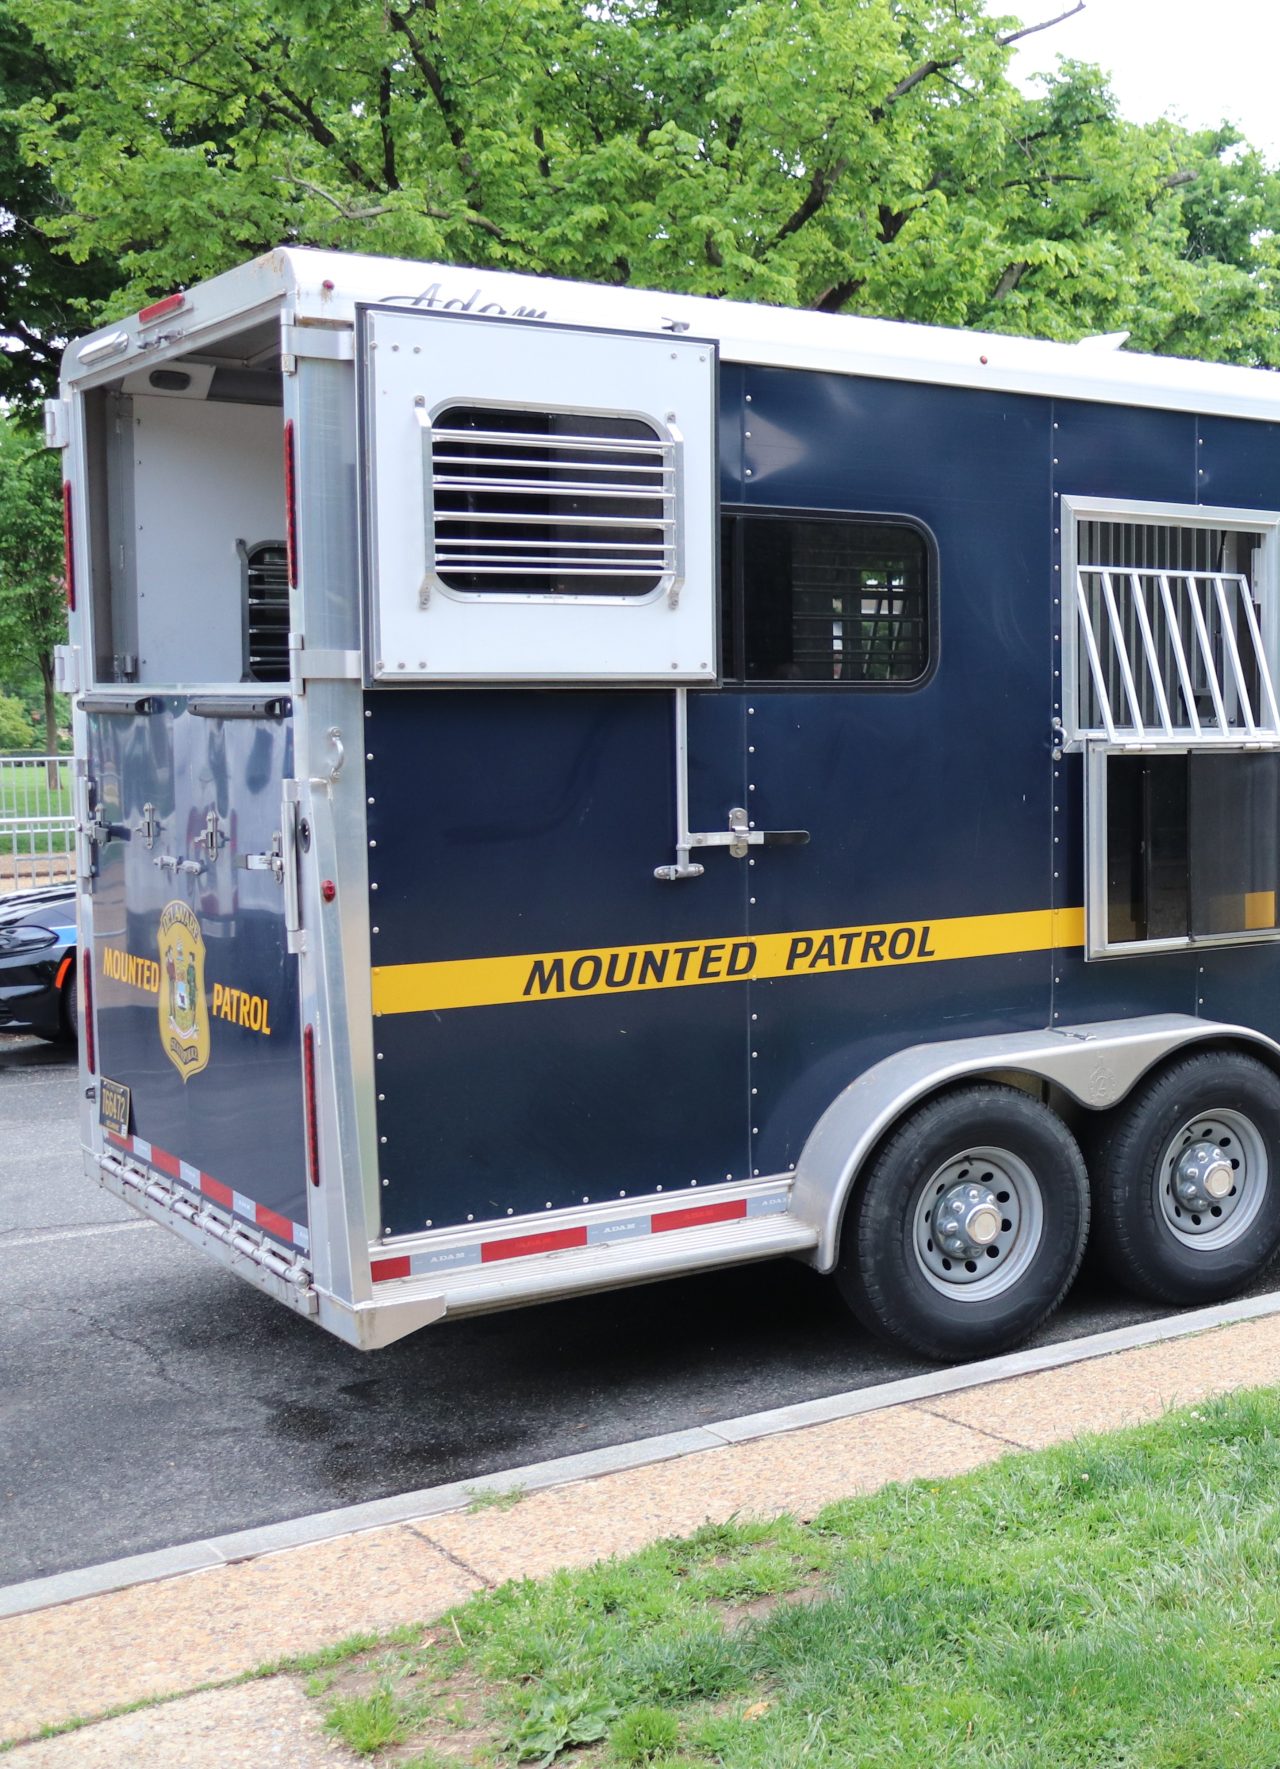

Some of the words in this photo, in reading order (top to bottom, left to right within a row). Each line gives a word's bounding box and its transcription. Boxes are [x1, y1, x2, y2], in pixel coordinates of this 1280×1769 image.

[522, 942, 757, 996] MOUNTED
[785, 926, 936, 970] PATROL
[103, 947, 160, 993] MOUNTED
[213, 982, 271, 1035] PATROL
[603, 1223, 636, 1234] ADAM
[429, 1251, 465, 1264] ADAM
